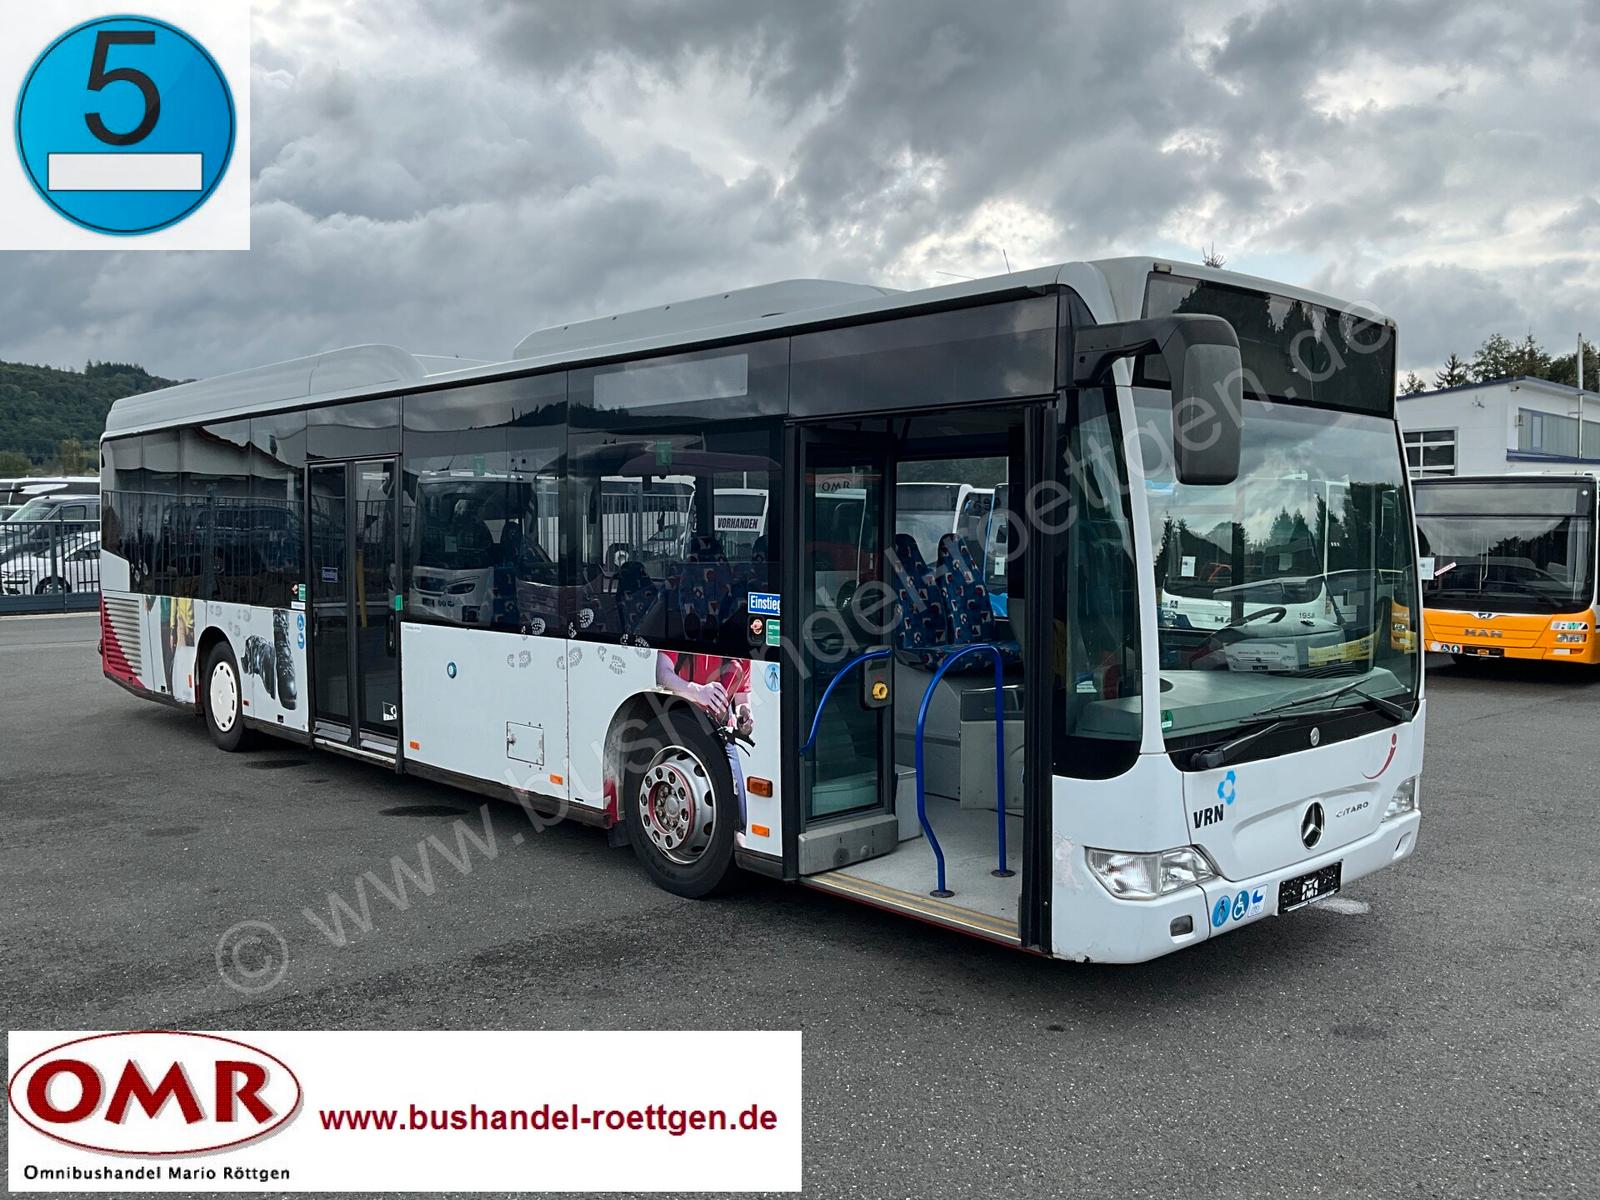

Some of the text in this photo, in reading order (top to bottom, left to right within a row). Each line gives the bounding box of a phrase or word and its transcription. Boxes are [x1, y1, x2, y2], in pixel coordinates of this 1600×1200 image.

[717, 517, 759, 529] VORHANDEN
[1464, 628, 1503, 638] MAN
[1193, 803, 1225, 829] VRN
